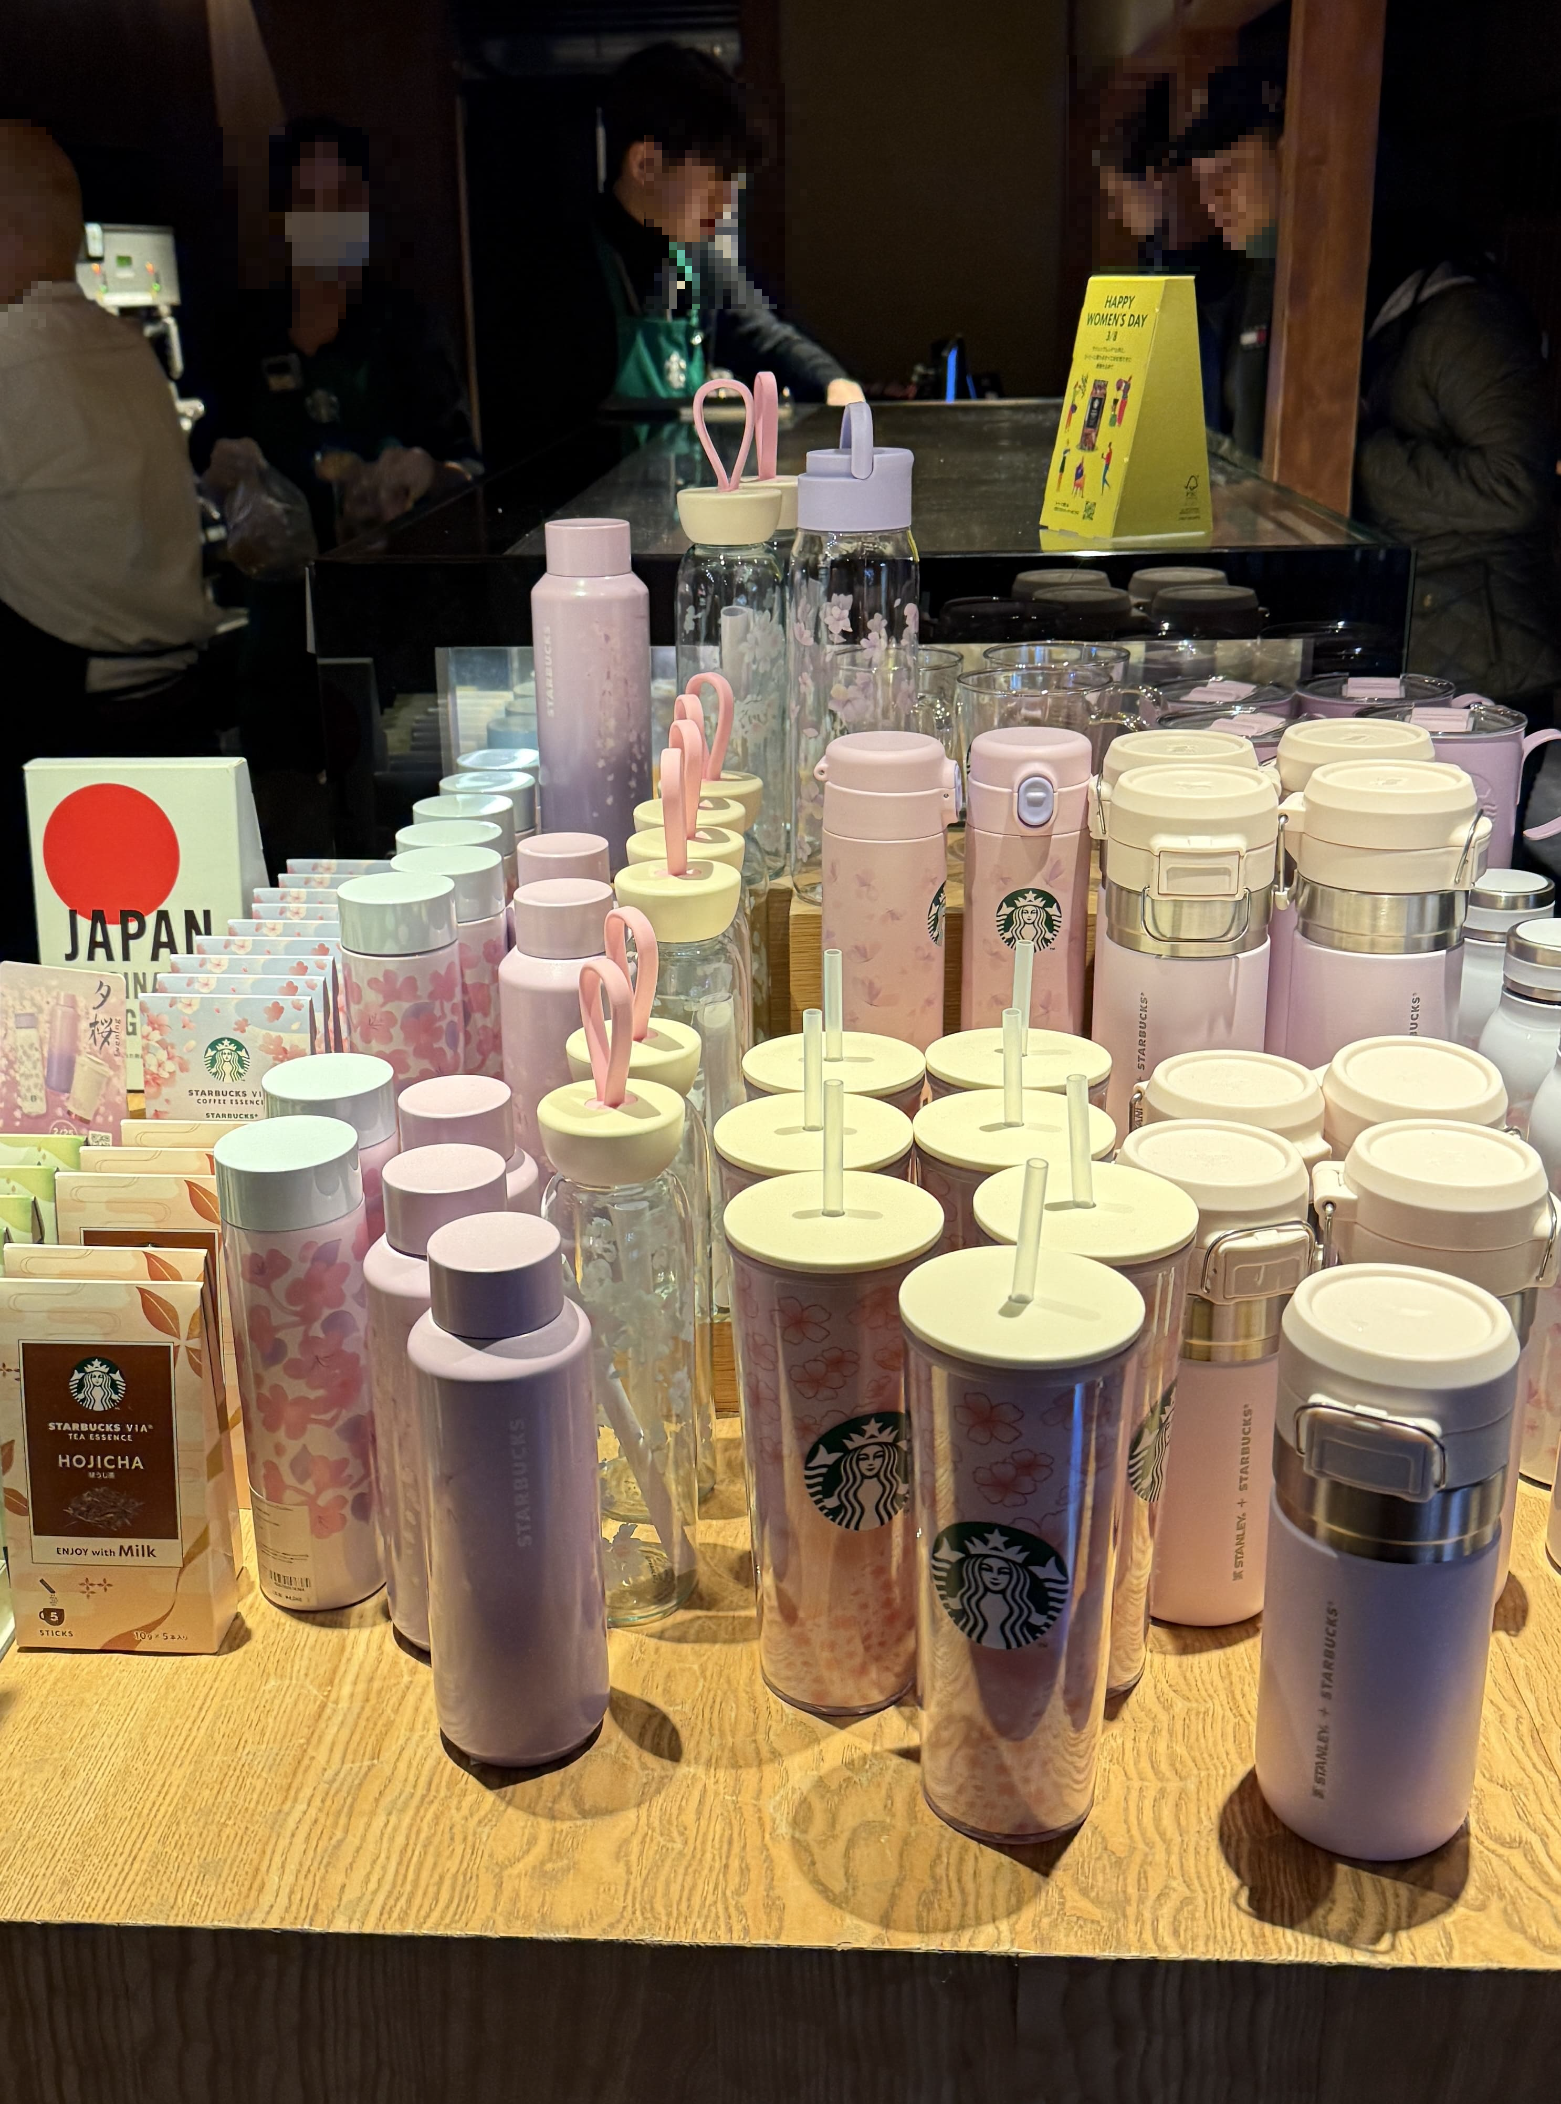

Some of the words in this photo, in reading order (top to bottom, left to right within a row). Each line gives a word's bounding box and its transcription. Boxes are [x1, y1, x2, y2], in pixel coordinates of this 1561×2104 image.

[1104, 295, 1135, 309] HAPPY
[1087, 312, 1126, 327] WOMEN'S
[1127, 313, 1148, 328] DAY
[65, 909, 212, 961] JAPAN
[1137, 995, 1148, 1071] STARBUCKS
[188, 1089, 247, 1098] STARBUCKS
[48, 1422, 121, 1432] STARBUCKS
[89, 1434, 133, 1442] ESSENCE
[1238, 1405, 1253, 1492] STARBUCKS
[58, 1454, 144, 1470] HOJICHA
[509, 1417, 533, 1548] STARBUCKS
[1234, 1513, 1247, 1568] STANLEY
[56, 1547, 88, 1556] ENJOY
[91, 1547, 116, 1557] with
[118, 1544, 157, 1558] Milk
[50, 1611, 59, 1621] 5
[39, 1629, 74, 1637] STICKS
[1320, 1602, 1338, 1700] STARBUCKS
[1314, 1725, 1330, 1786] STANLEY
